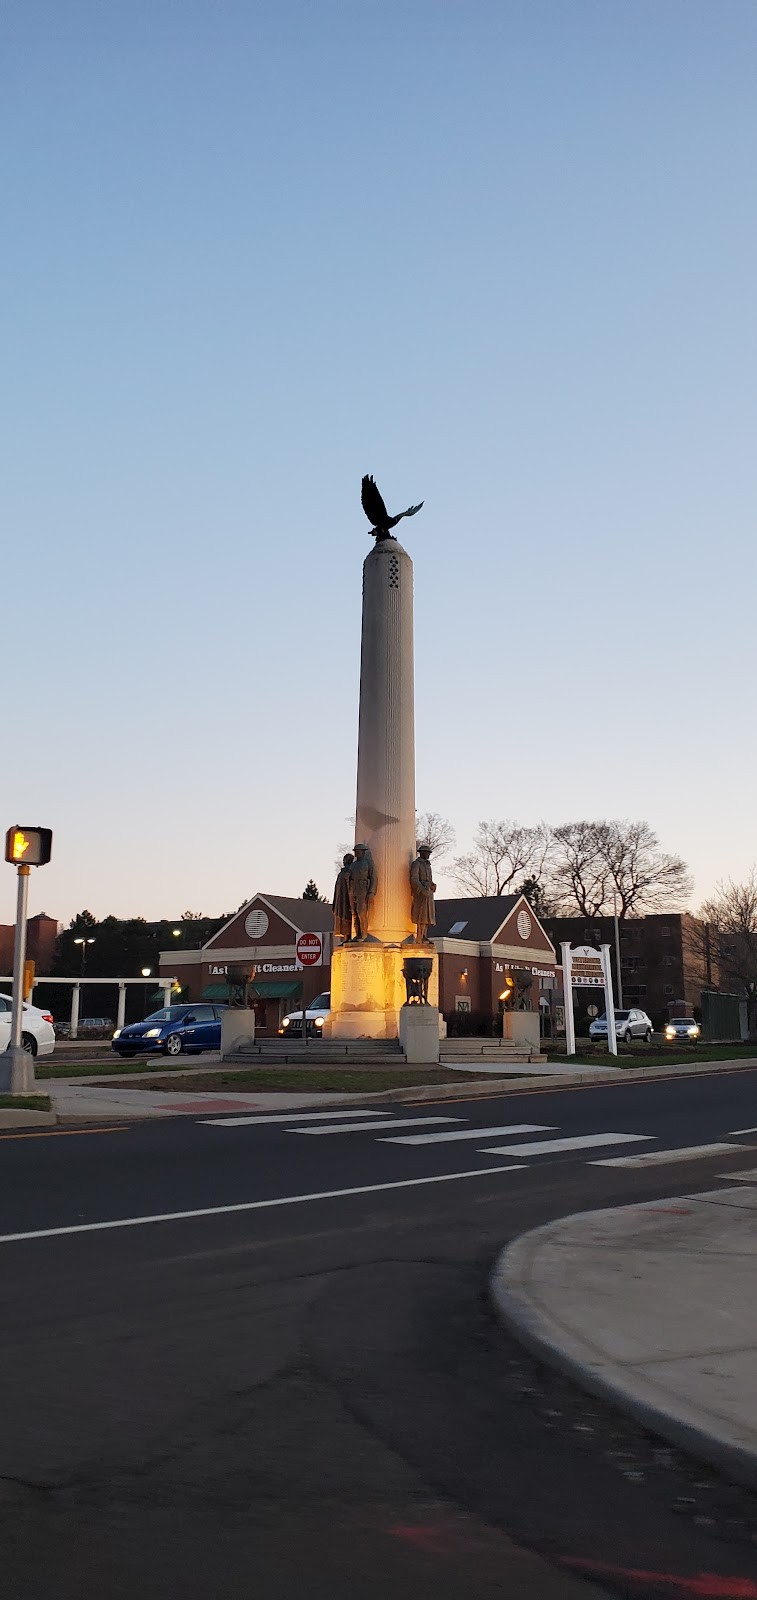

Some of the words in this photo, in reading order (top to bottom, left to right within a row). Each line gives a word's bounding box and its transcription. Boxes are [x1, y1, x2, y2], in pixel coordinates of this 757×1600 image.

[262, 964, 303, 973] Cleaners
[495, 963, 503, 972] As
[531, 967, 555, 977] Cleaners
